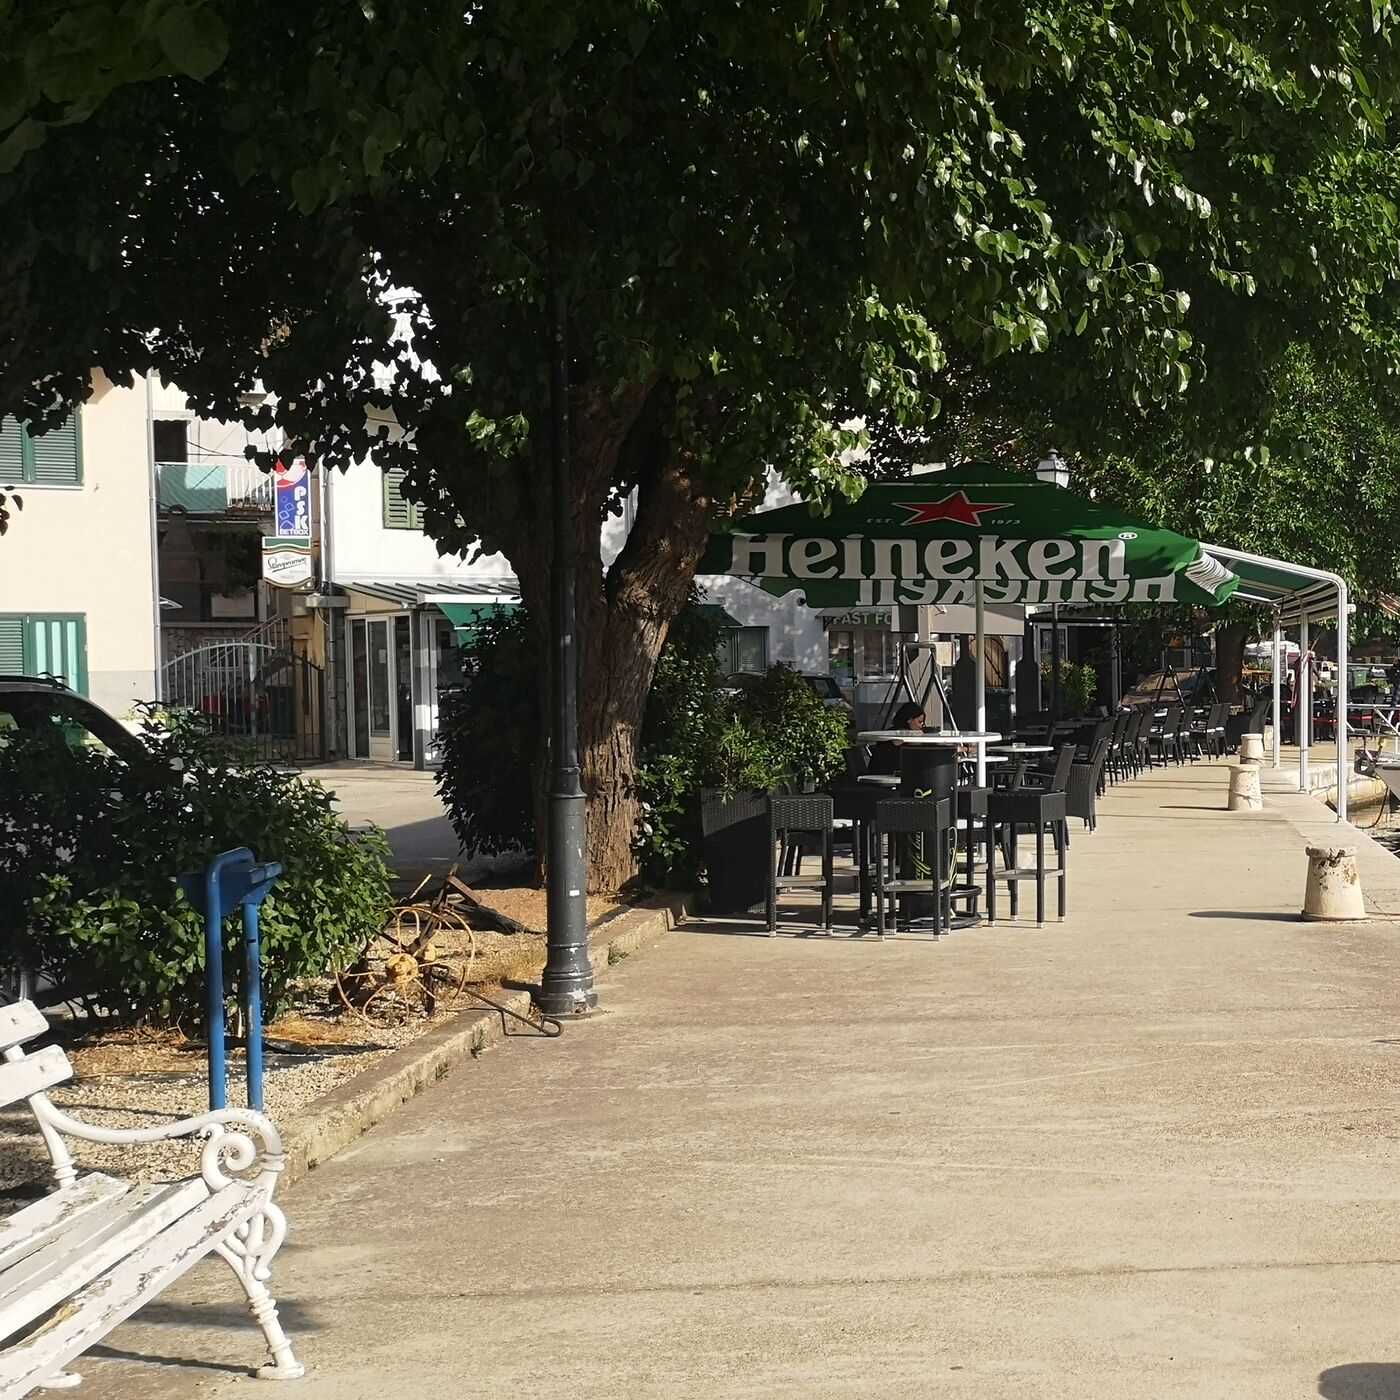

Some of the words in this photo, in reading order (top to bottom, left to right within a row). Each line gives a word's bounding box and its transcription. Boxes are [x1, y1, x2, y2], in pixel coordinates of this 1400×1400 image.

[294, 486, 308, 530] PSK
[724, 533, 1130, 580] Heineken
[875, 612, 892, 625] FO
